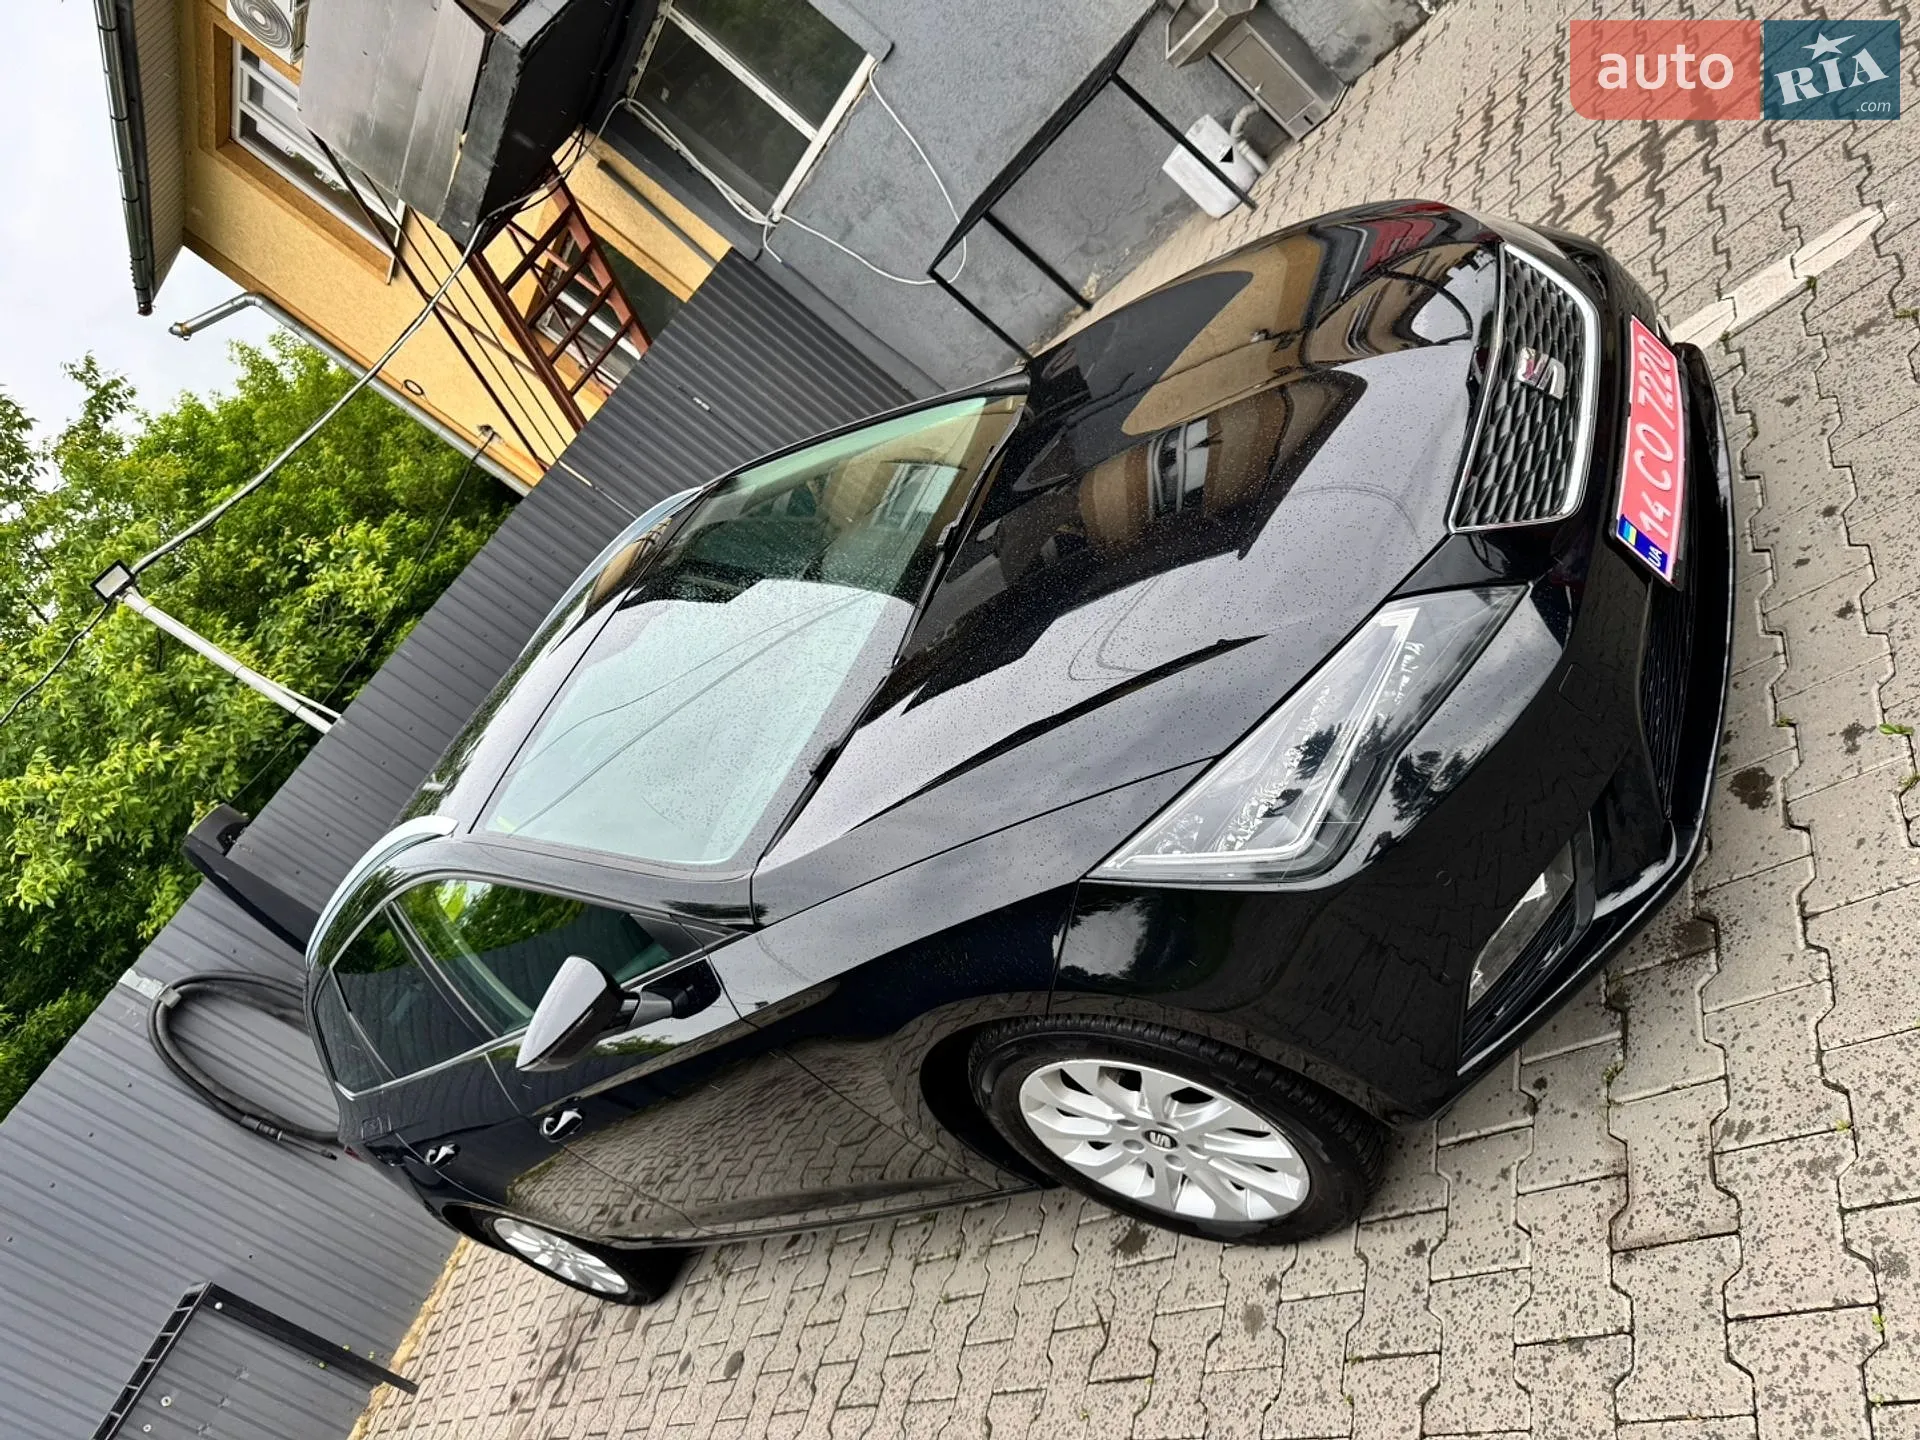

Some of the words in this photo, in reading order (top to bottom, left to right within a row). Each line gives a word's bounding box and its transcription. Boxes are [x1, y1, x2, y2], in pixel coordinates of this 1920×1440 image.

[1637, 334, 1676, 430] 7220
[1634, 423, 1674, 491] CO
[1638, 491, 1672, 538] 14
[1647, 545, 1664, 569] UA
